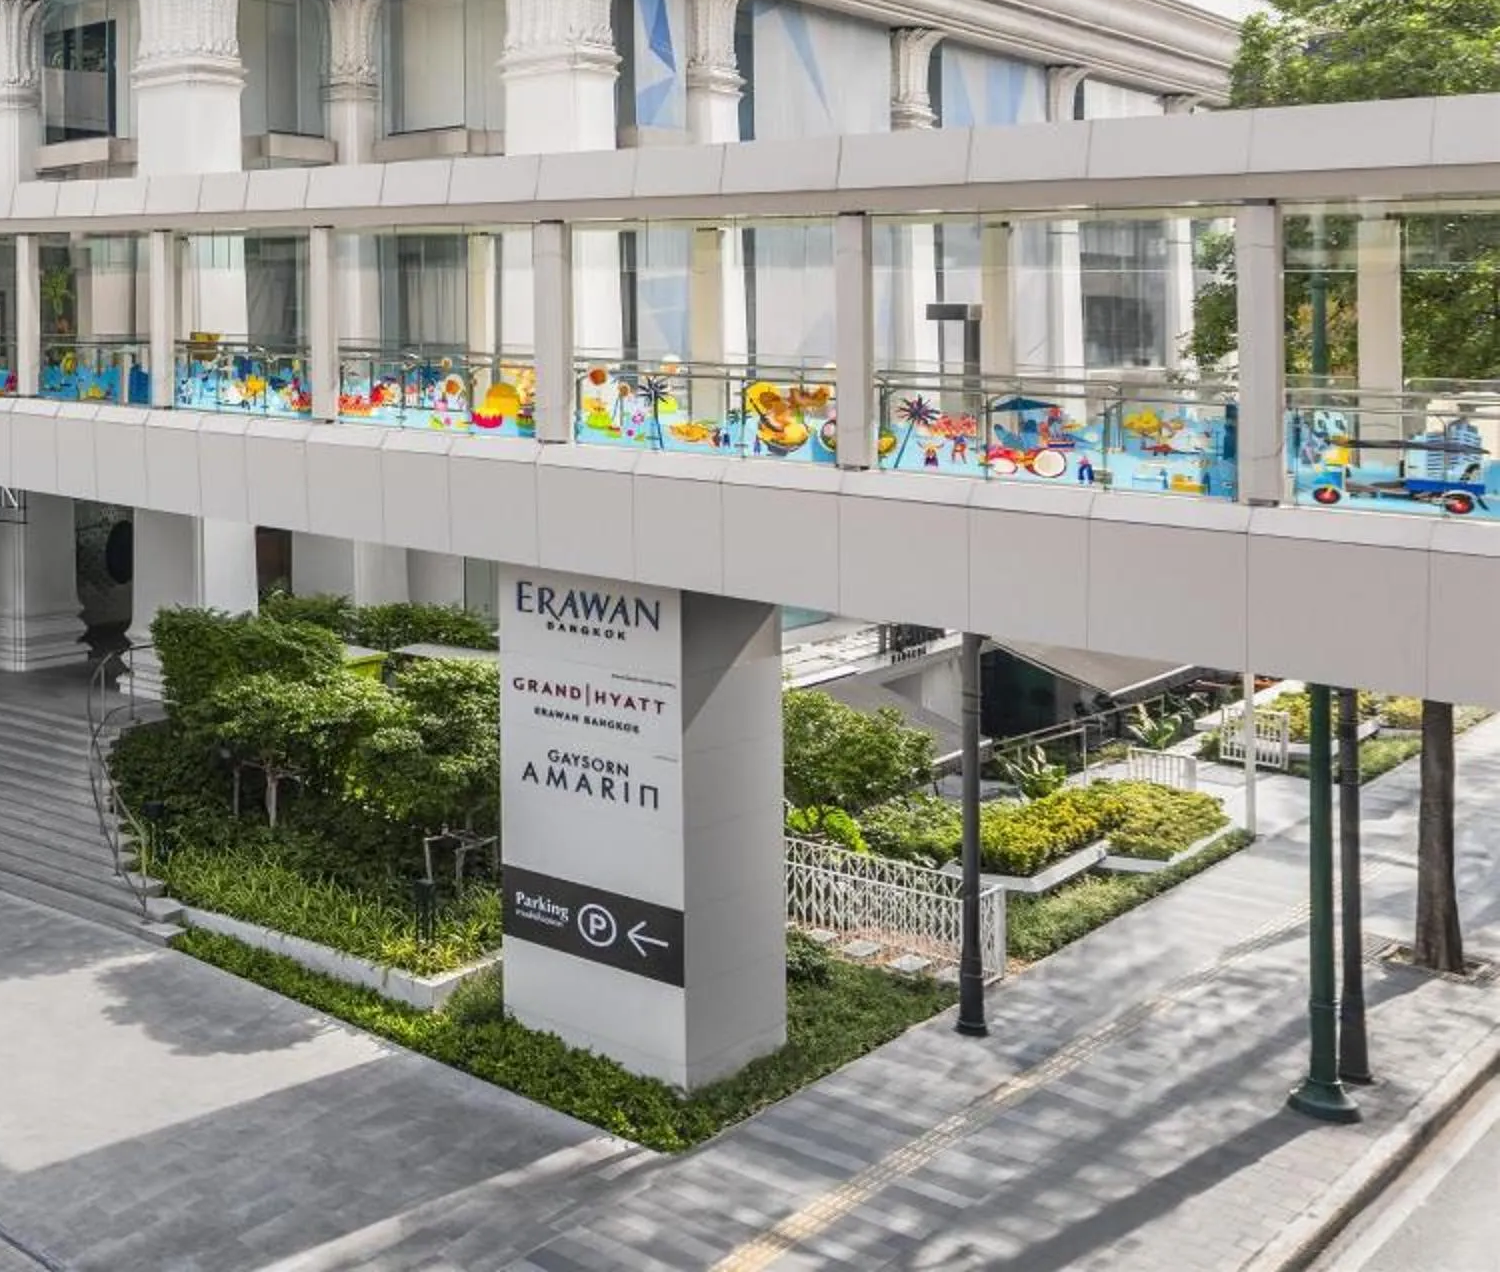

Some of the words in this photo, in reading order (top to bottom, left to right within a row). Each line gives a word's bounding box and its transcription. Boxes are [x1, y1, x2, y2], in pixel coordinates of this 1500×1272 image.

[516, 581, 660, 632] ERAWAN
[547, 621, 626, 640] BANGKOK
[513, 678, 582, 700] GRAND
[595, 691, 666, 715] HYATT
[534, 706, 579, 723] ERAWAN
[583, 715, 640, 734] BANGKOK
[547, 749, 630, 777] GAYSORN
[515, 891, 569, 923] Parking
